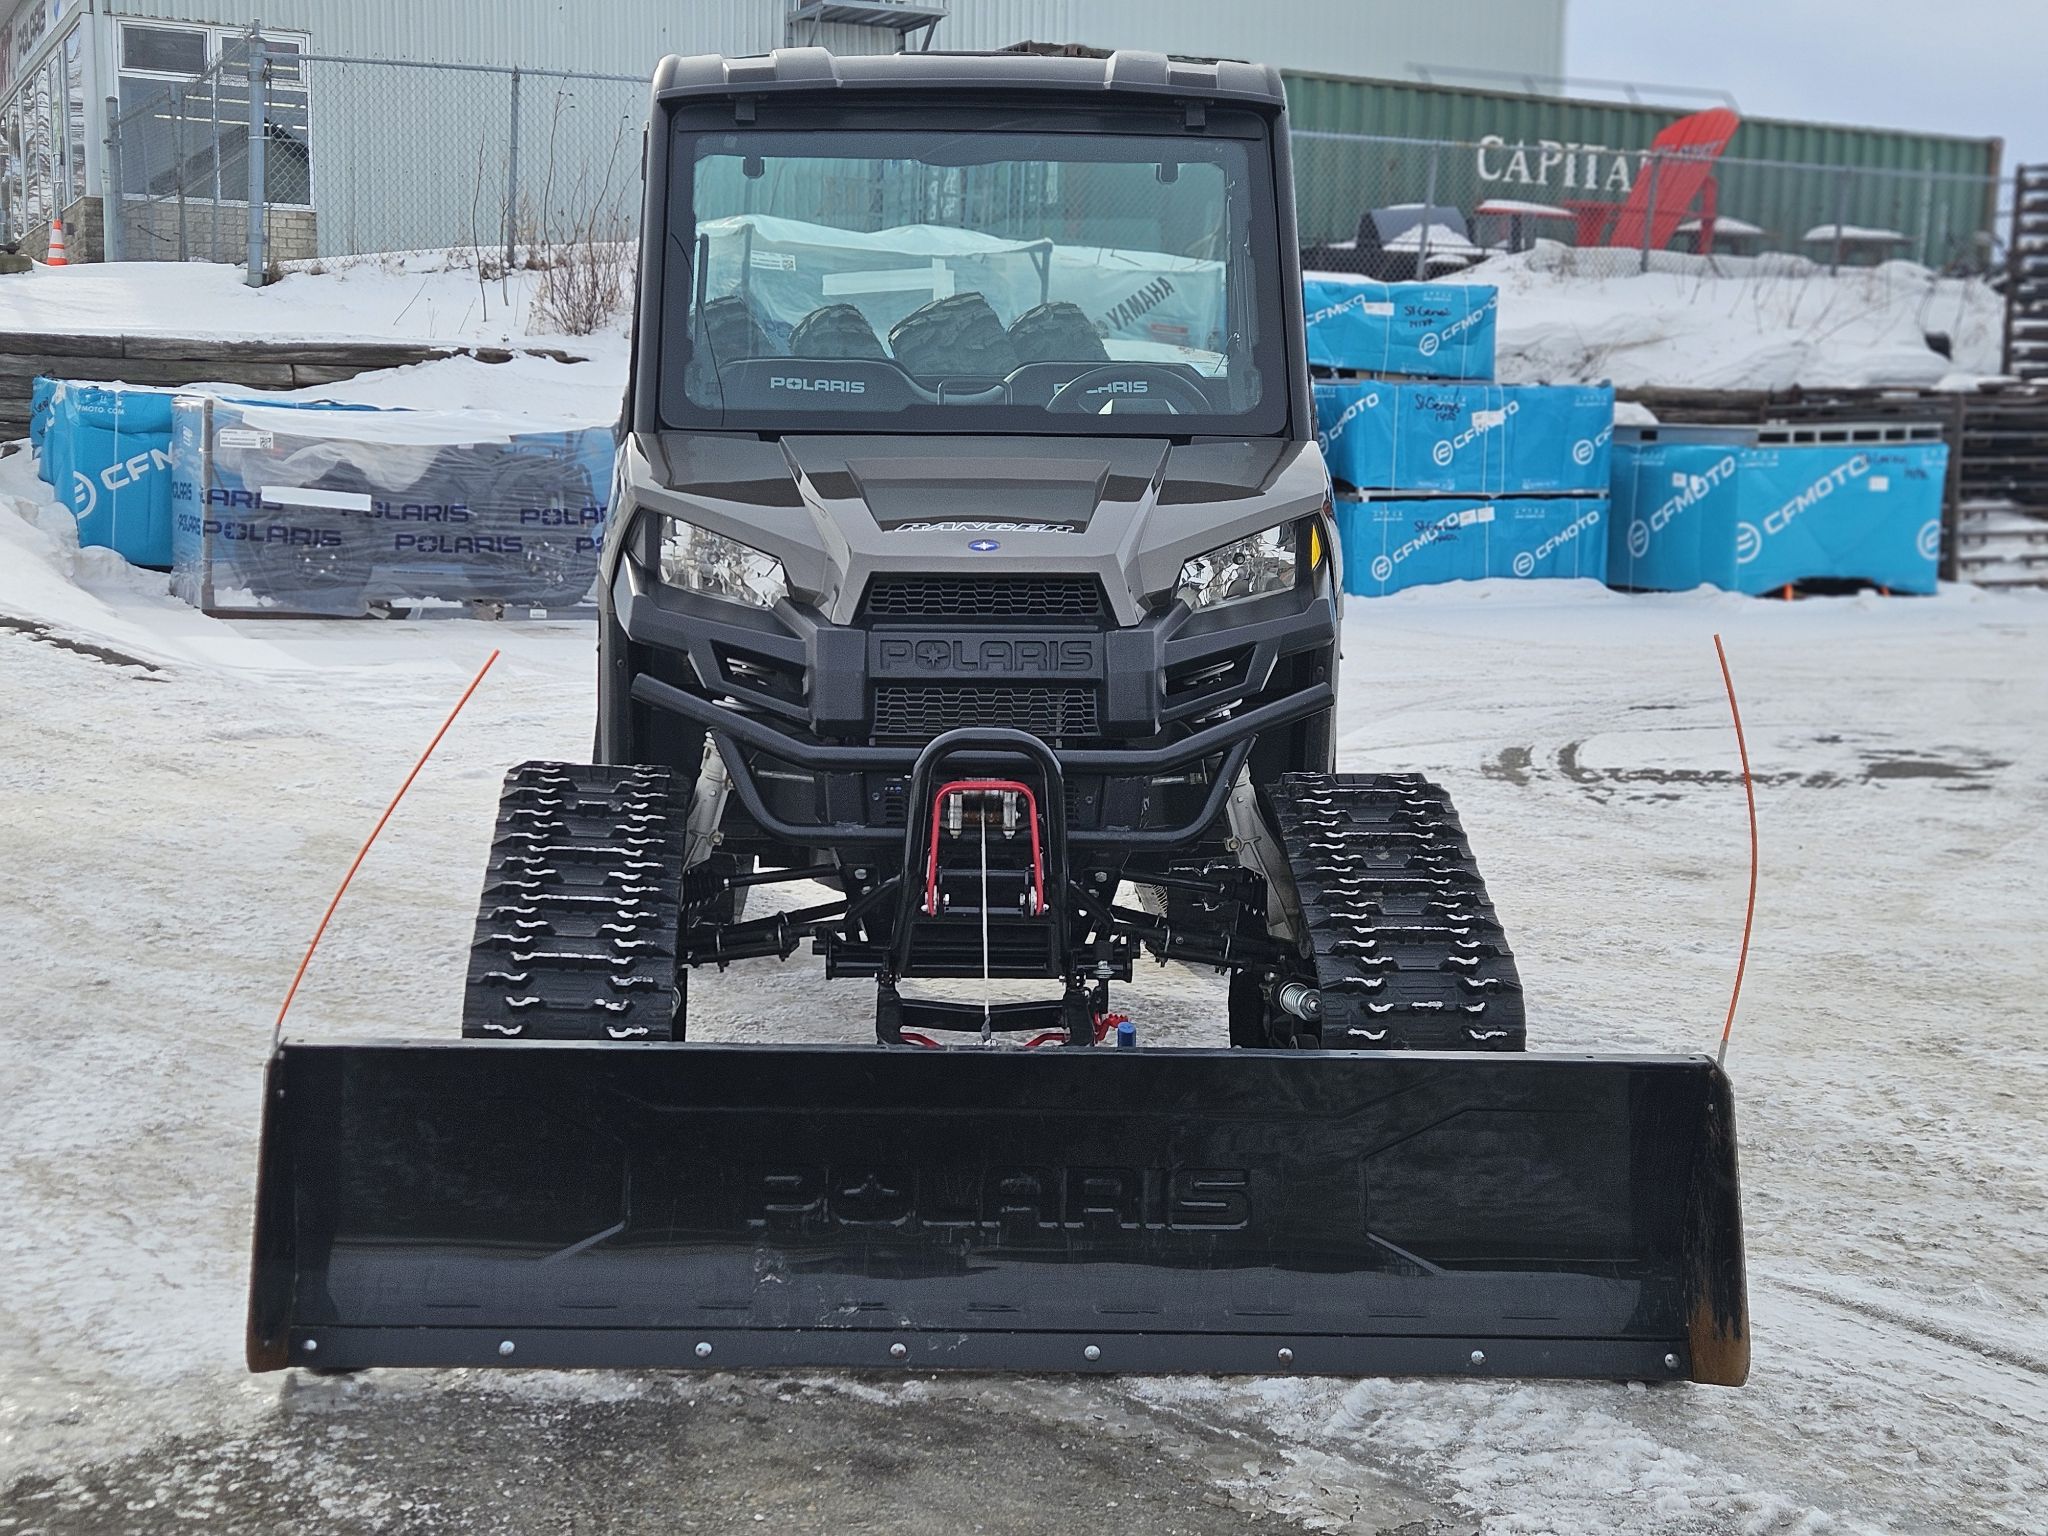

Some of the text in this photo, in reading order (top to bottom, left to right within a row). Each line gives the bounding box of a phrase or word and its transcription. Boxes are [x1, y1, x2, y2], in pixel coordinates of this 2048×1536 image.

[1477, 135, 1653, 192] CAPITA
[1106, 276, 1175, 331] YAMAHA
[770, 376, 865, 394] POLARIS
[341, 502, 469, 523] OLARIS
[1650, 456, 1735, 532] CFMOTO
[1763, 455, 1870, 534] CFMOTO
[203, 520, 342, 547] POLARIS
[395, 534, 523, 554] POLARIS
[894, 521, 1075, 534] RANGER
[1393, 512, 1459, 563] CFMOTO
[1536, 510, 1600, 559] CFMOTO
[879, 640, 1093, 671] POLARIS
[746, 1166, 1252, 1232] POLARIS
